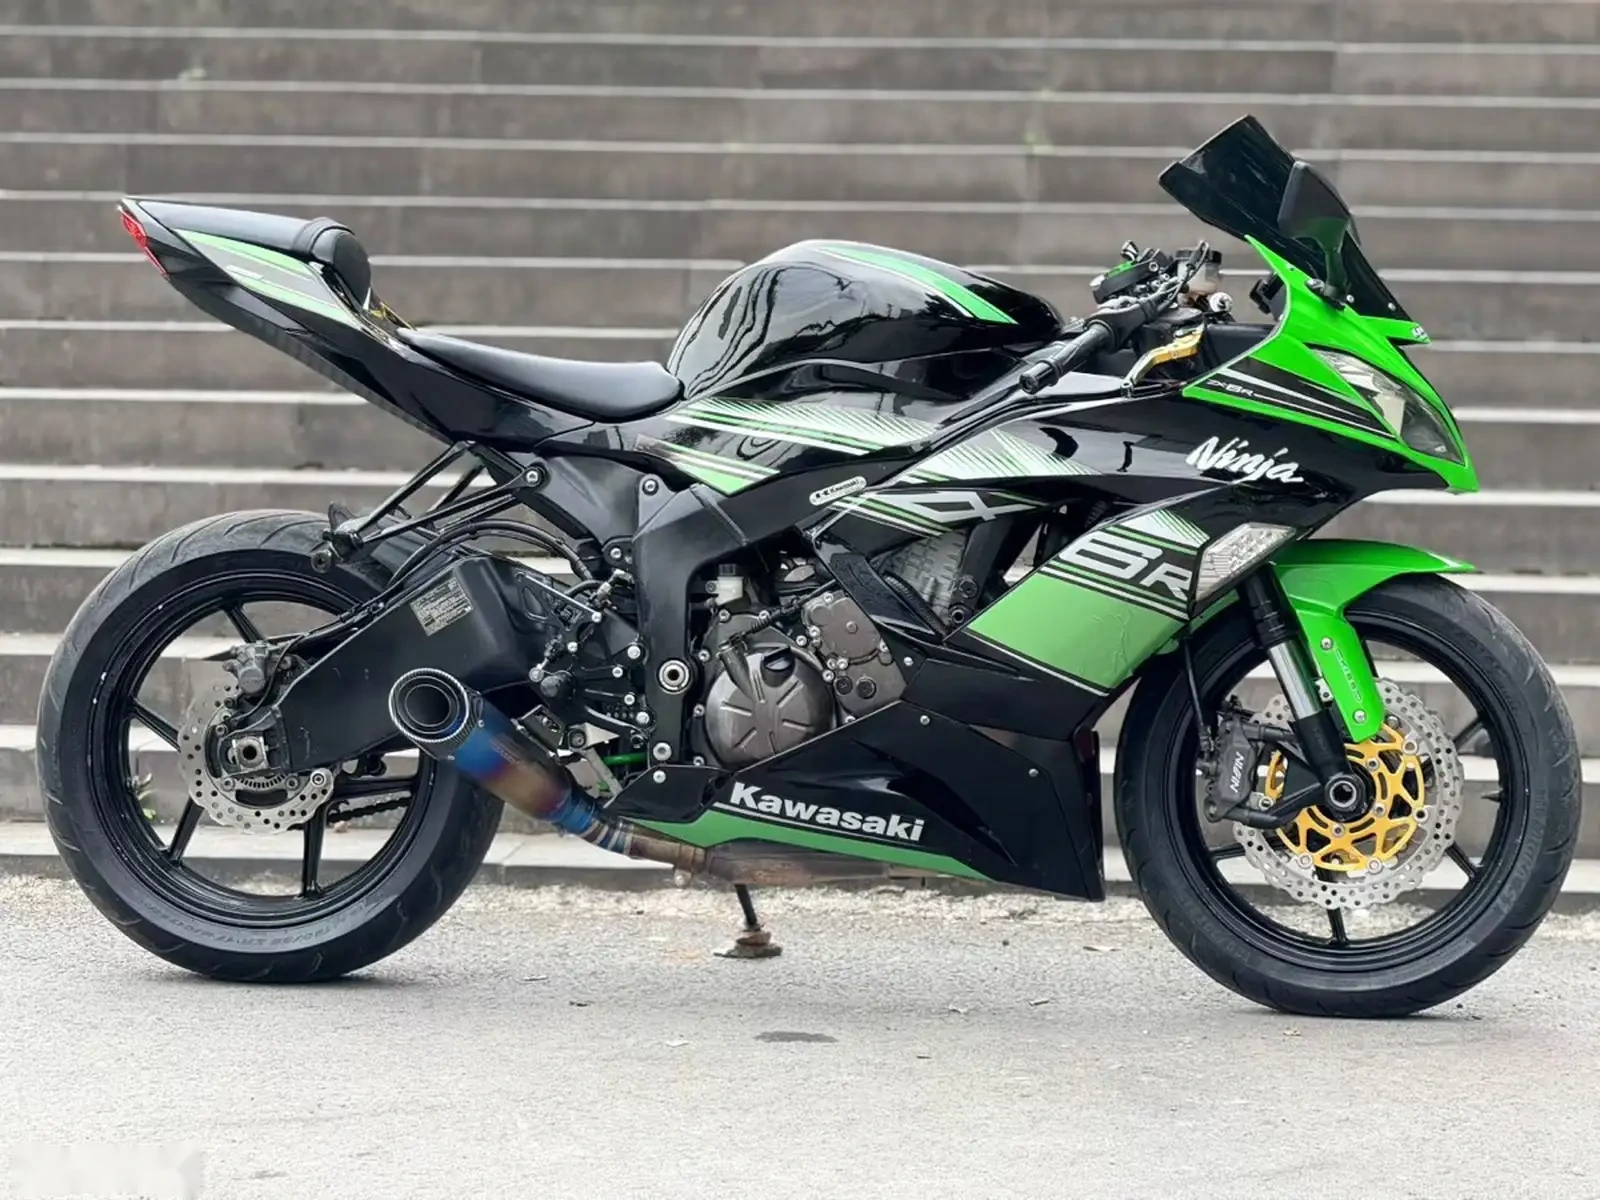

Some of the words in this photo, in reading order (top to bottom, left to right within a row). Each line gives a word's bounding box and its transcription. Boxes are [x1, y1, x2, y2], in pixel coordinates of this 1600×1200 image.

[1185, 436, 1304, 485] Ninja
[1058, 530, 1193, 601] 6R
[730, 781, 925, 842] Kawasaki
